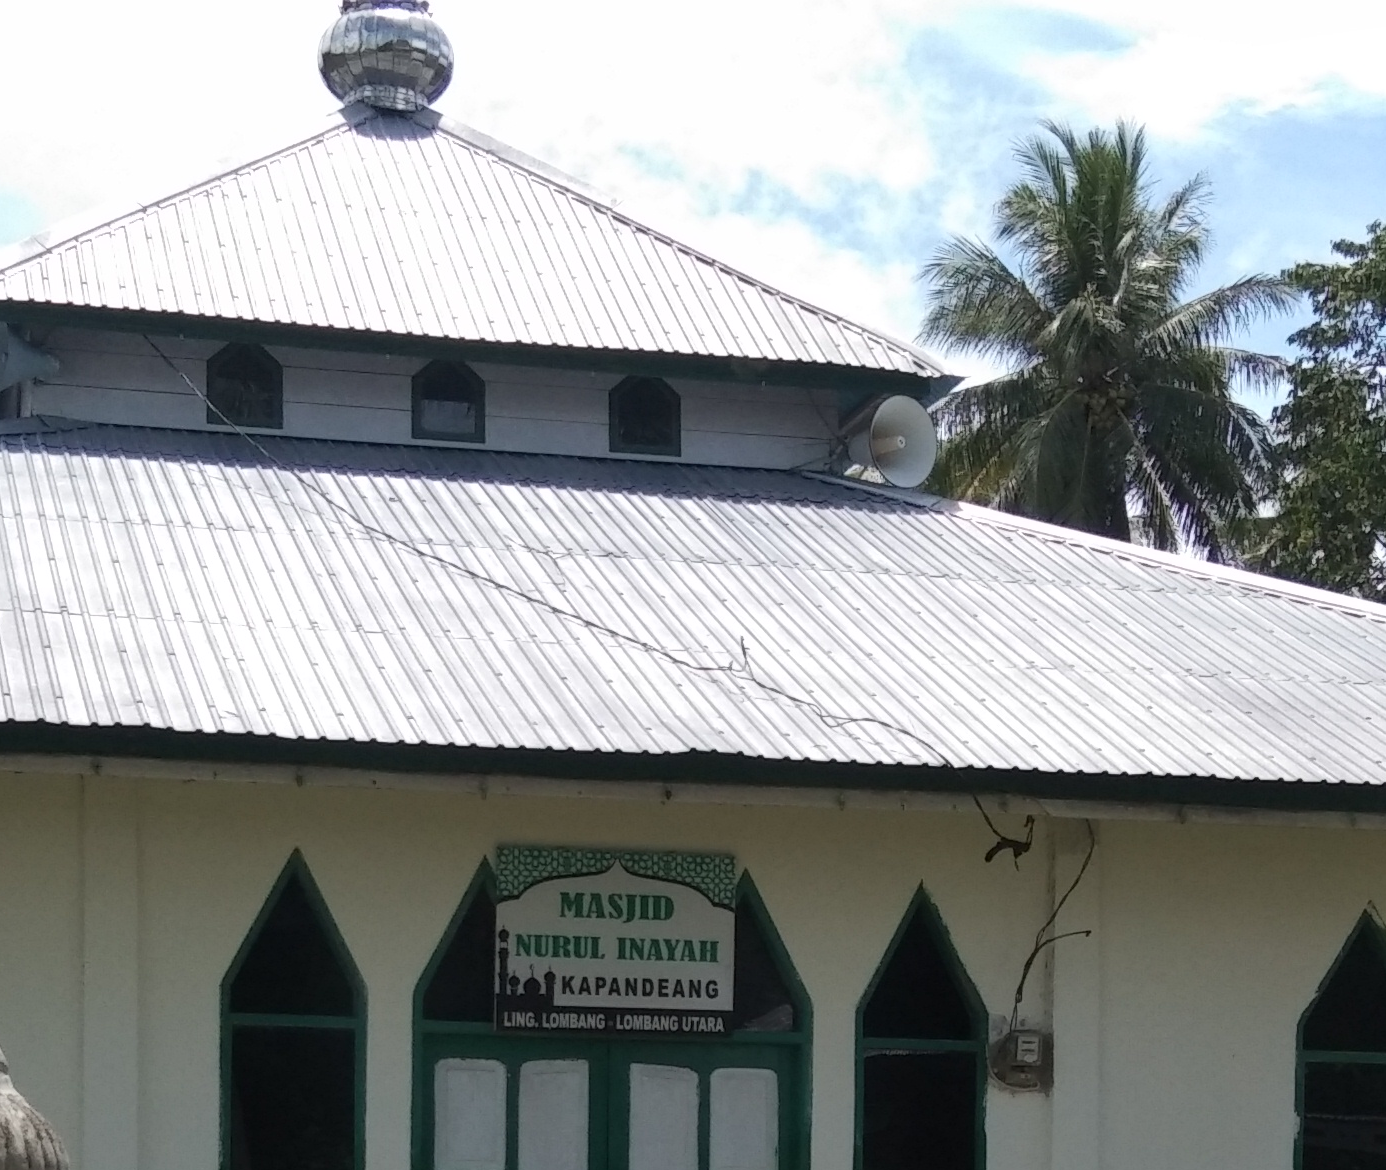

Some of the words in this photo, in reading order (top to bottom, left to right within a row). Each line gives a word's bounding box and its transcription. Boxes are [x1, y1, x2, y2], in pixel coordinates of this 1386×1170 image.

[559, 892, 675, 923] MASJID
[514, 933, 606, 960] NURUL
[616, 937, 719, 963] INAYAH
[561, 976, 719, 999] KAPANDEANG
[503, 1011, 539, 1028] LING.
[542, 1013, 606, 1030] LOMBANG
[616, 1014, 679, 1031] LOMBANG
[681, 1015, 725, 1032] UTARA
